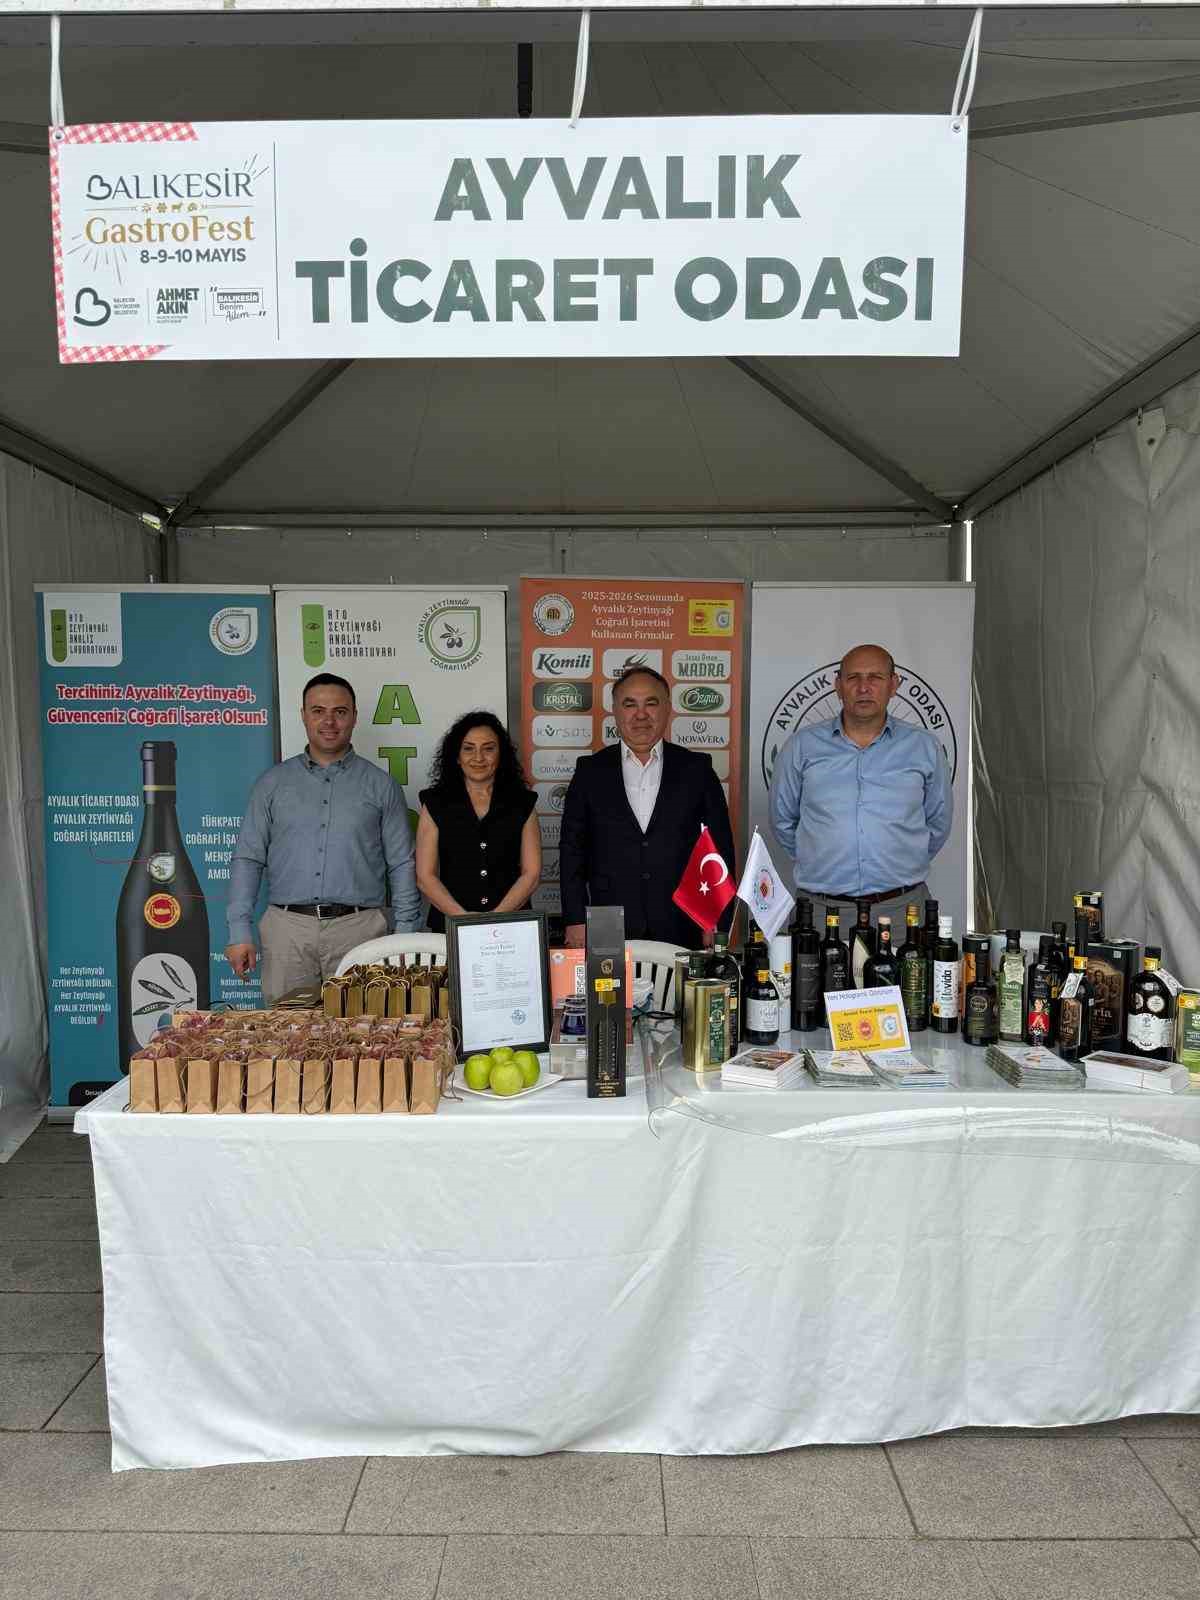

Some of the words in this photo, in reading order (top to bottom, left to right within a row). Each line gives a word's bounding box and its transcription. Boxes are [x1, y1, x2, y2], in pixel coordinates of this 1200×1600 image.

[86, 168, 254, 200] BALIKESİR
[434, 154, 802, 221] AYVALIK
[85, 215, 255, 245] GastroFest
[140, 249, 192, 264] 8-9-10
[195, 248, 246, 263] MAYIS
[295, 237, 654, 323] TİCARET
[673, 256, 934, 322] ODASI
[156, 288, 200, 301] AHMET
[156, 301, 189, 314] AKIN
[582, 592, 632, 602] 2025-2026
[634, 592, 685, 602] Sezonunda
[592, 604, 626, 614] Ayvalık
[627, 605, 674, 617] Zeytinyağı
[595, 616, 629, 627] Coğrafi
[591, 630, 632, 639] Kullanan
[536, 653, 591, 675] Komili
[678, 662, 726, 678] MADRA
[56, 684, 122, 701] Tercihiniz
[125, 684, 180, 702] Ayvalık
[179, 685, 256, 704] Zeytinyağı,
[776, 674, 832, 731] AYVALIK
[908, 684, 945, 730] ODASI
[48, 708, 125, 725] Güvenceniz
[127, 706, 177, 726] Coğrafi
[180, 705, 223, 727] İşaret
[223, 709, 268, 725] Olsun!
[677, 735, 725, 744] NOVAVERA
[47, 795, 80, 807] AYVALIK
[80, 793, 114, 807] TİCARET
[114, 795, 140, 807] ODASI
[53, 814, 86, 825] AYVALIK
[87, 811, 133, 825] ZEYTİNYAĞI
[202, 814, 243, 827] TÜRKPATE
[53, 829, 88, 843] COĞRAFİ
[89, 829, 134, 846] İŞARETLERİ
[186, 831, 221, 845] COĞRAFİ
[223, 831, 240, 848] İŞA
